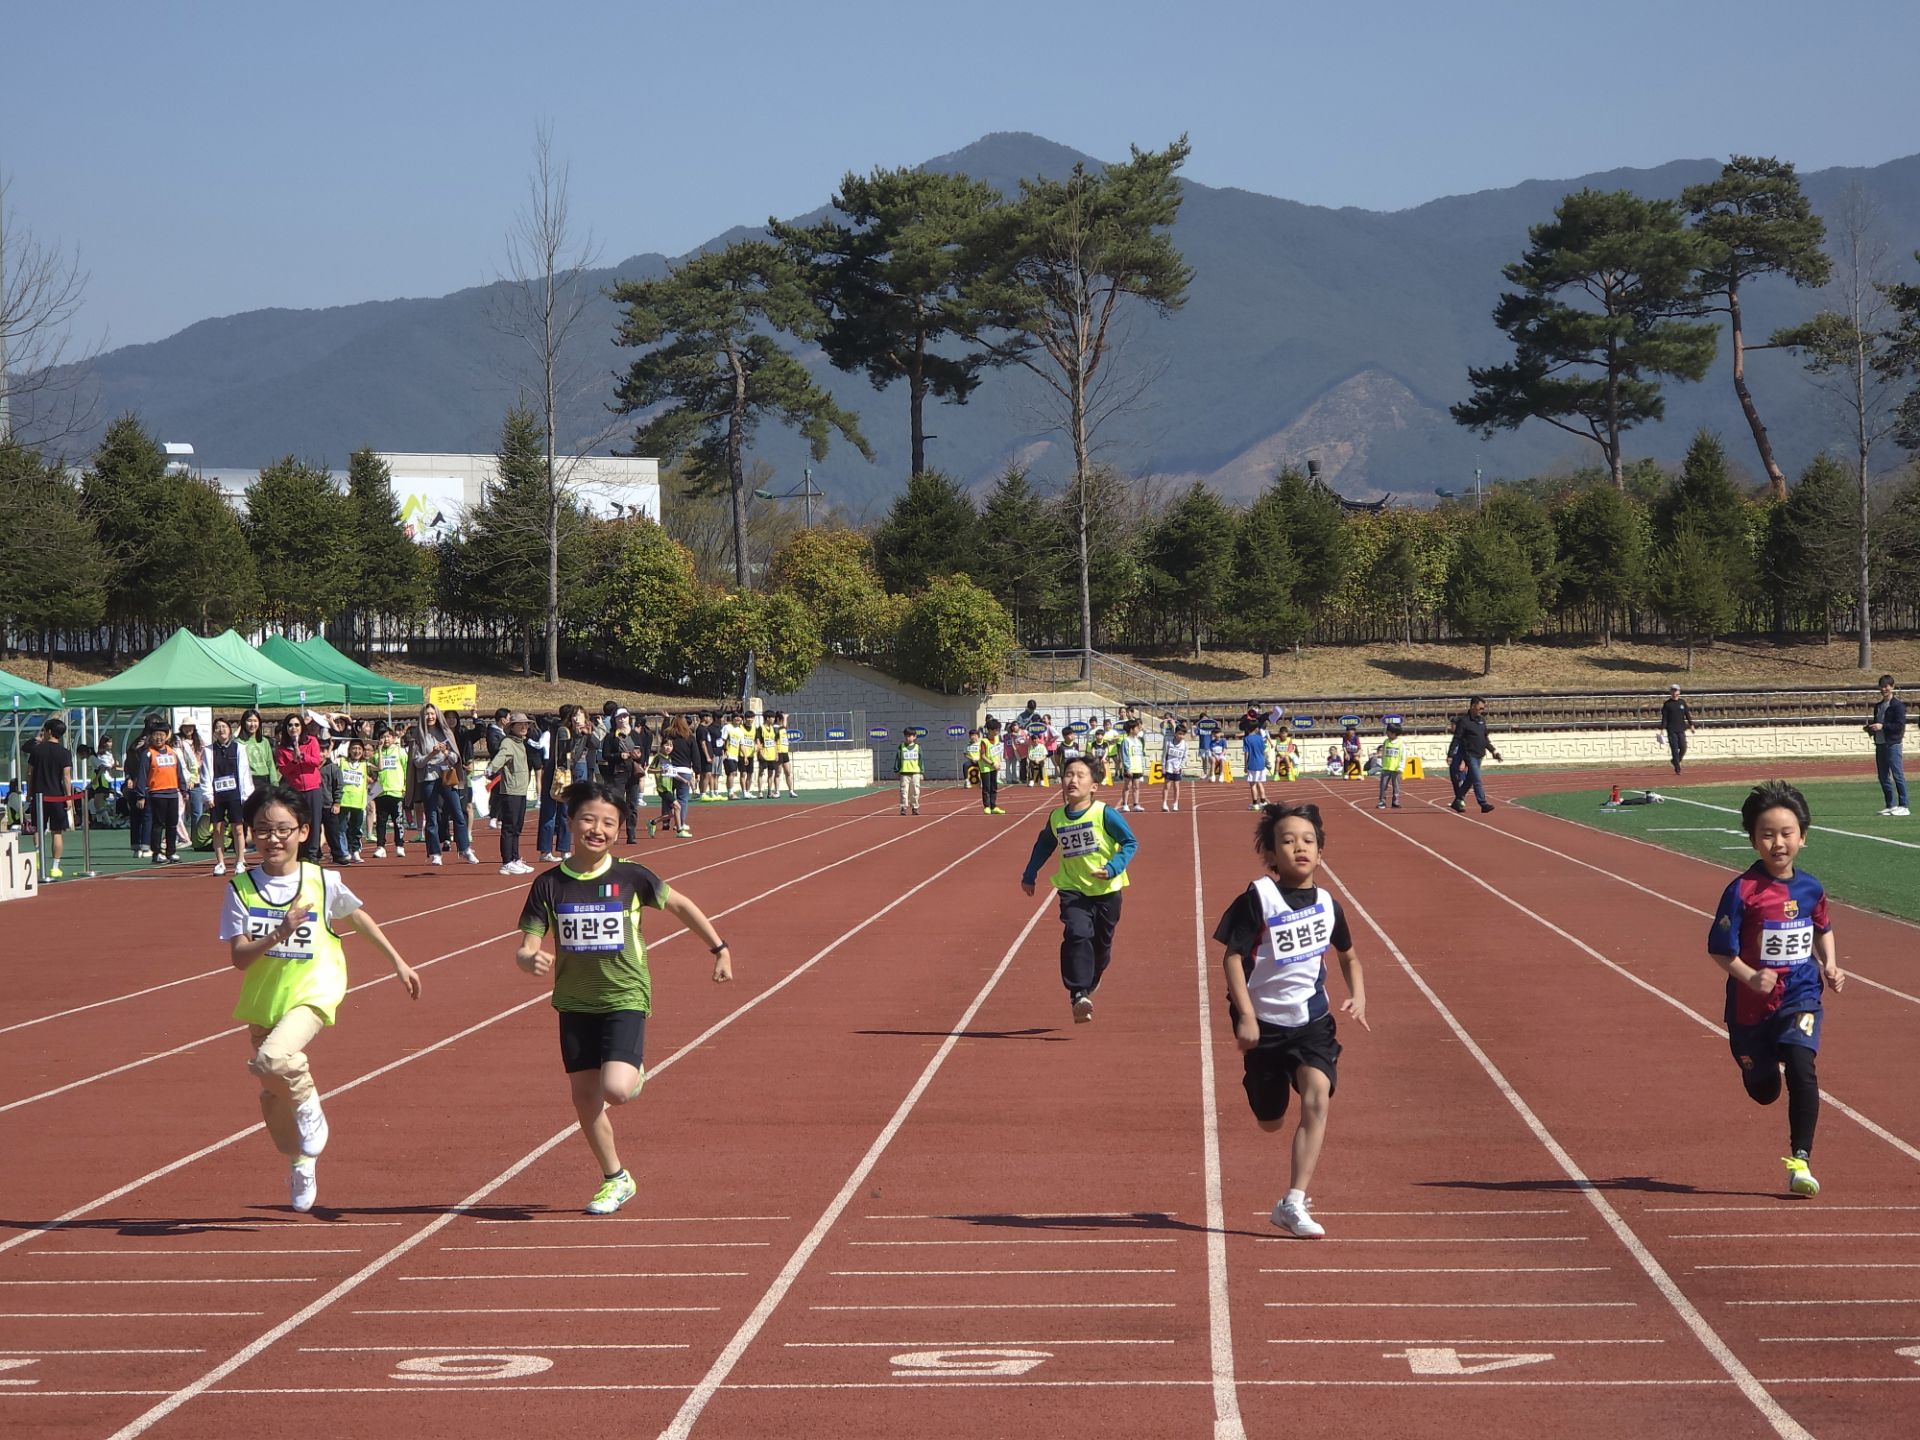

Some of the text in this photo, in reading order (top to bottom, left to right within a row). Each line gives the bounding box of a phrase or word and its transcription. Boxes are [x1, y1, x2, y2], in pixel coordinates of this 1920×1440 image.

[969, 768, 979, 785] 8
[1154, 764, 1164, 780] 5
[1407, 758, 1416, 775] 1
[1061, 830, 1095, 850] 오진원
[6, 841, 14, 889] 1
[24, 858, 33, 891] 2
[562, 917, 620, 940] 허관우
[1275, 918, 1327, 952] 정범준
[1765, 931, 1811, 956] 송준우
[888, 1348, 1054, 1378] 5
